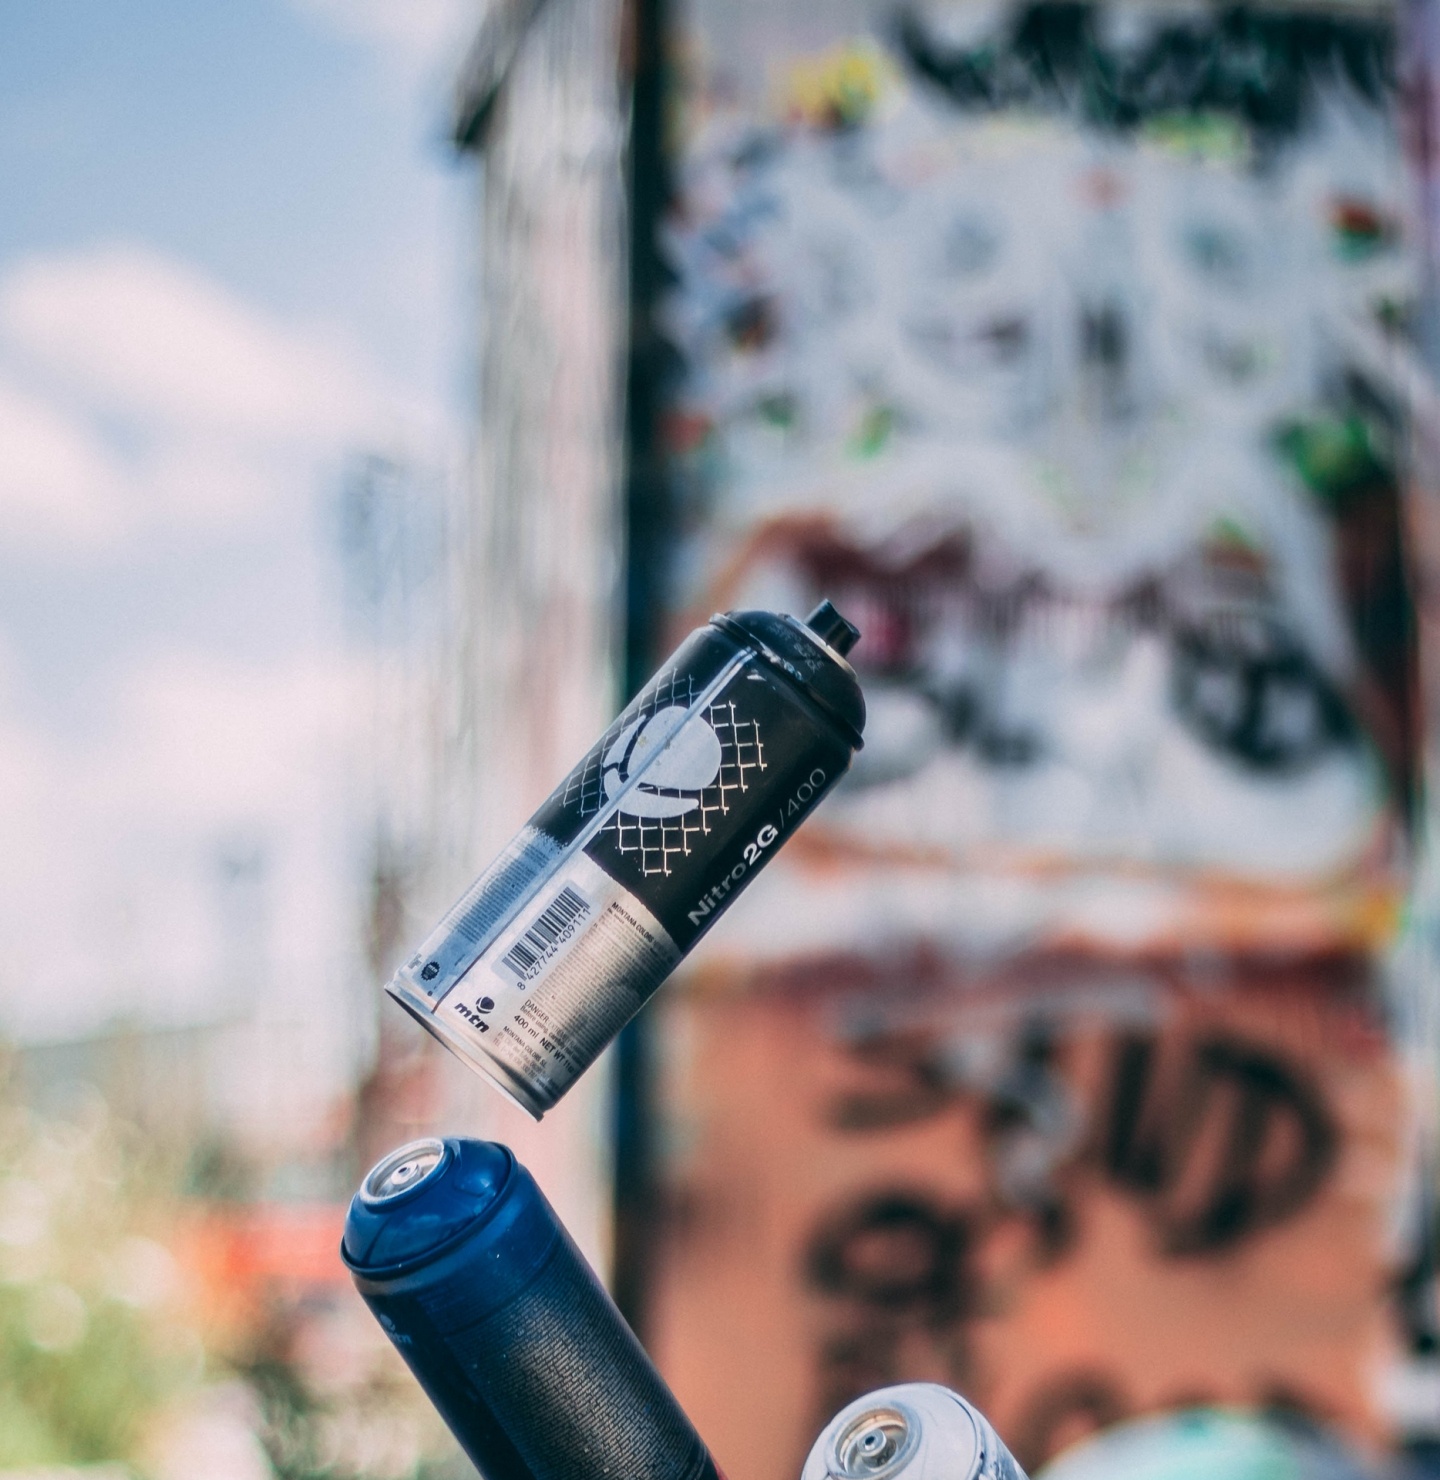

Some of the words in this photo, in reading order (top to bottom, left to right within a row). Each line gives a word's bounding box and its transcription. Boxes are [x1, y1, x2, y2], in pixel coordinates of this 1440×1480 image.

[611, 901, 637, 927] MONTANA
[454, 1002, 490, 1033] mtn
[514, 1014, 529, 1029] 400
[527, 1028, 540, 1039] ml
[540, 1037, 556, 1054] NET
[554, 1049, 565, 1064] WT
